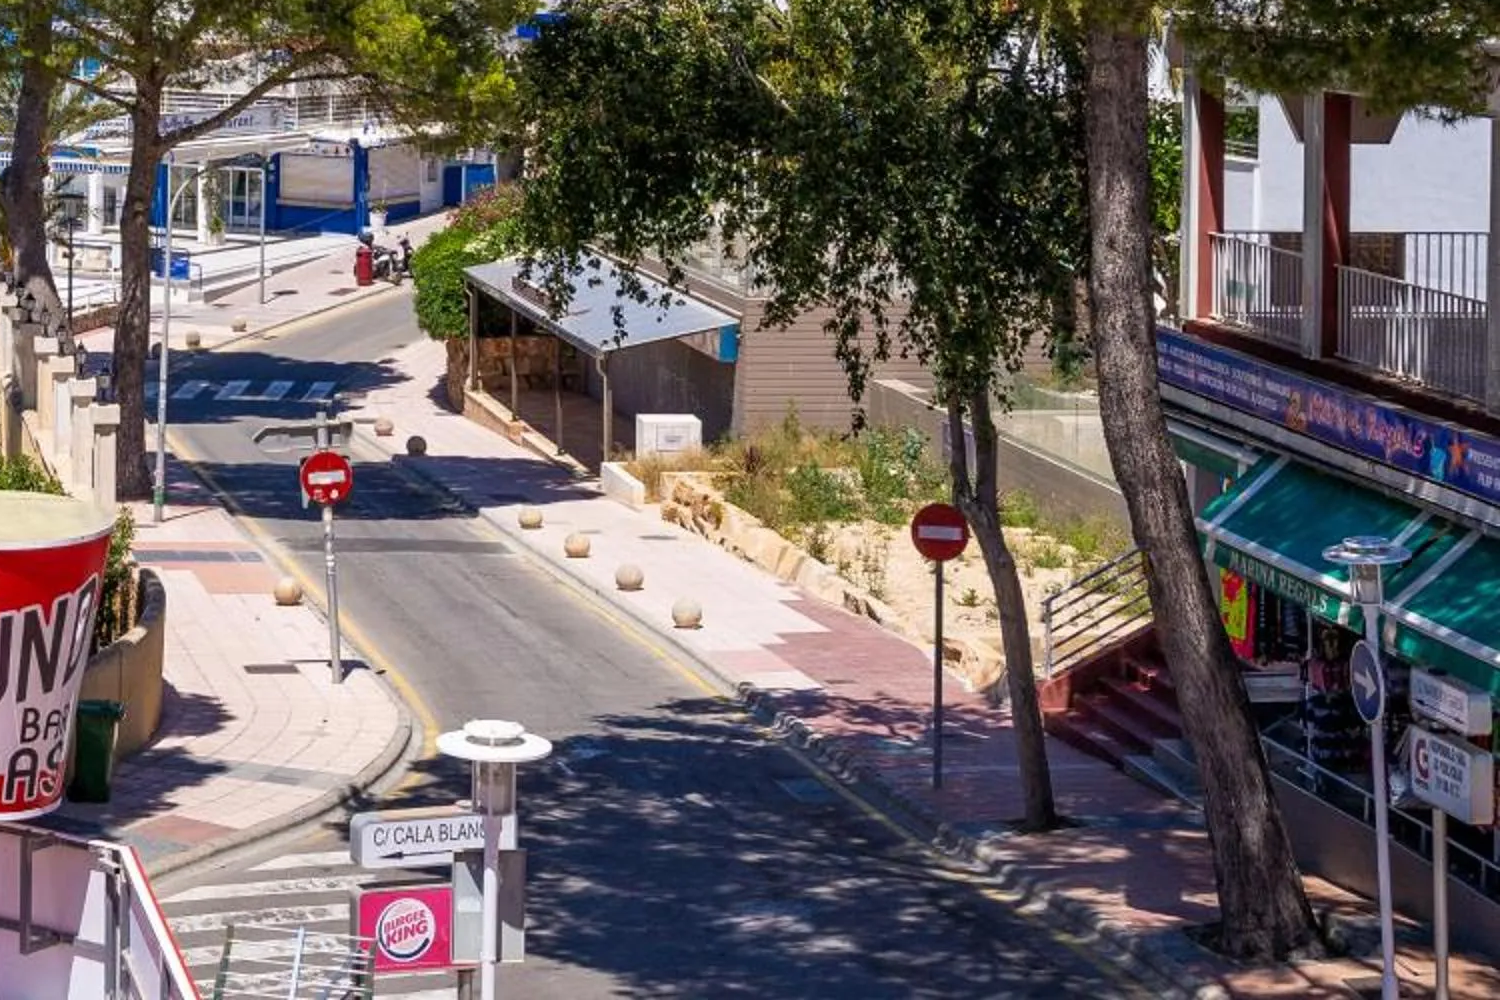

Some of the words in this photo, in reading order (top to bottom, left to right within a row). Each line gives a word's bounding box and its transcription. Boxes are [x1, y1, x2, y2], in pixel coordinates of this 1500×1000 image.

[1229, 550, 1275, 588] MARINA
[1278, 575, 1329, 612] REGALS
[373, 827, 390, 846] C/
[393, 825, 435, 845] CALA
[383, 909, 426, 934] BURGER
[386, 919, 429, 948] KING
